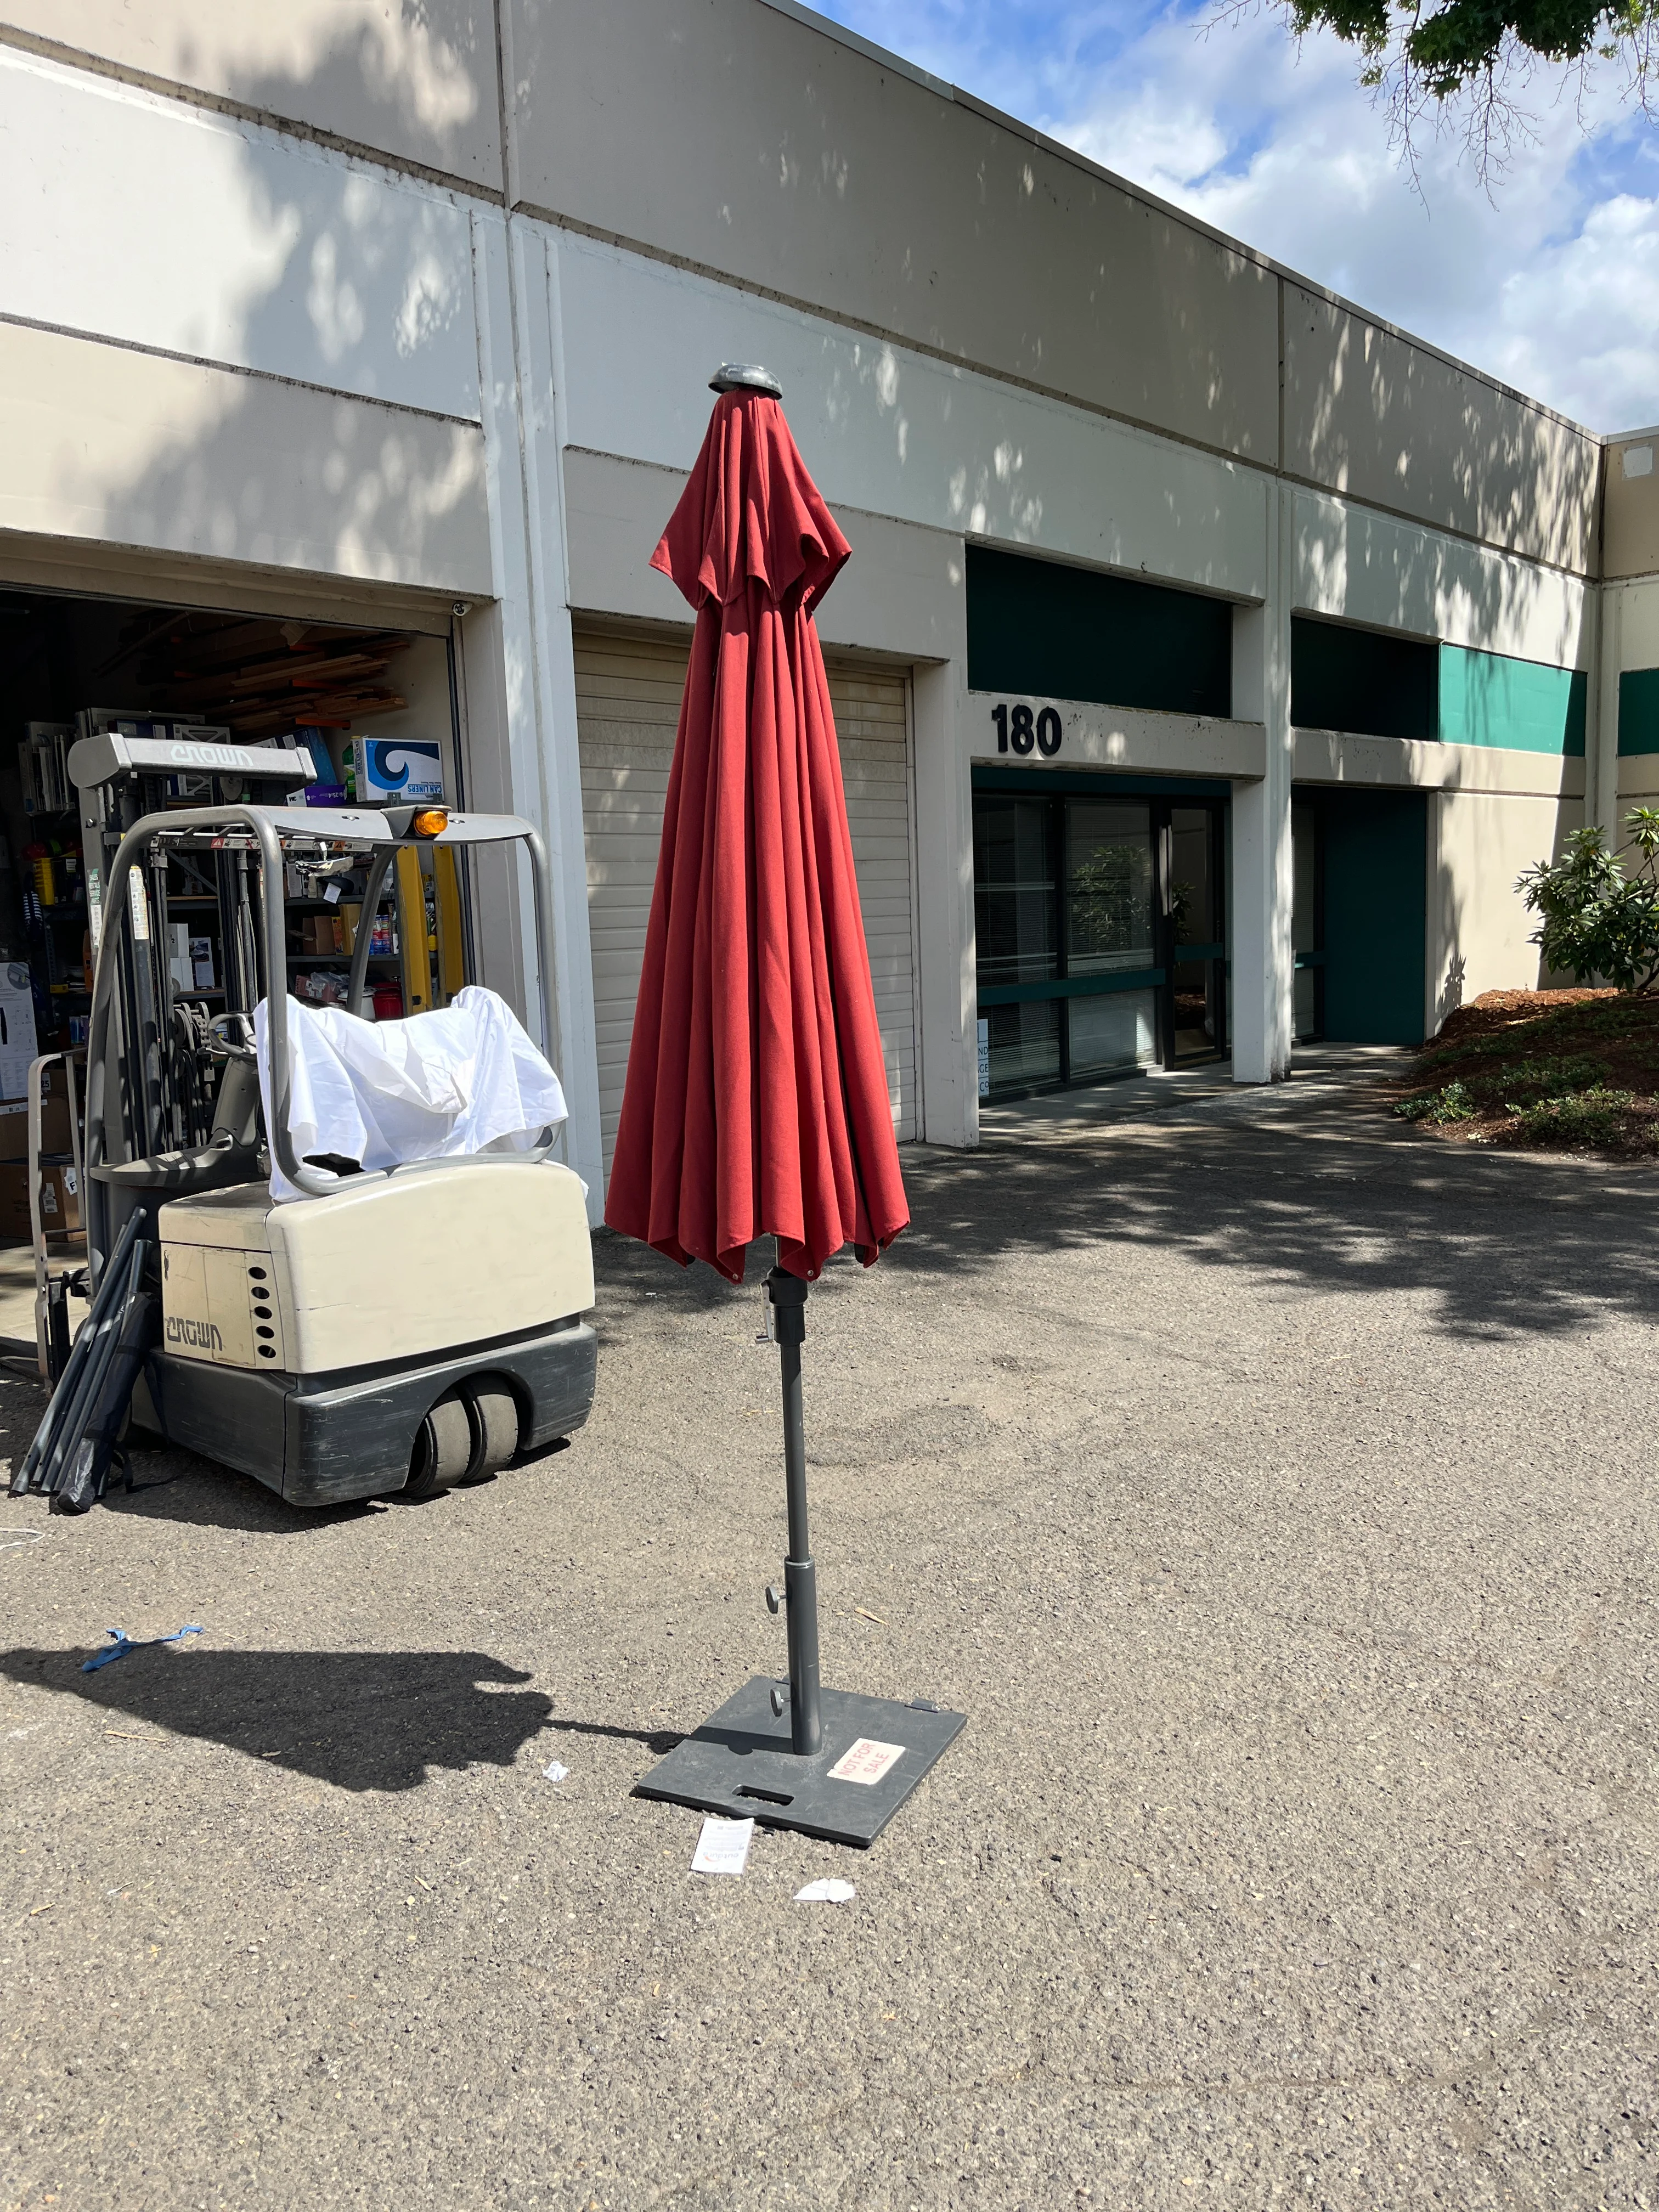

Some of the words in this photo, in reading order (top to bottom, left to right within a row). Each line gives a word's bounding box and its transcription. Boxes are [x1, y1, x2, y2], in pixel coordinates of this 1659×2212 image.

[991, 704, 1062, 756] 180
[430, 785, 442, 793] CAN
[978, 1063, 989, 1074] GE
[838, 1758, 861, 1776] NOT
[853, 1742, 876, 1759] FOR
[863, 1753, 890, 1773] SALE
